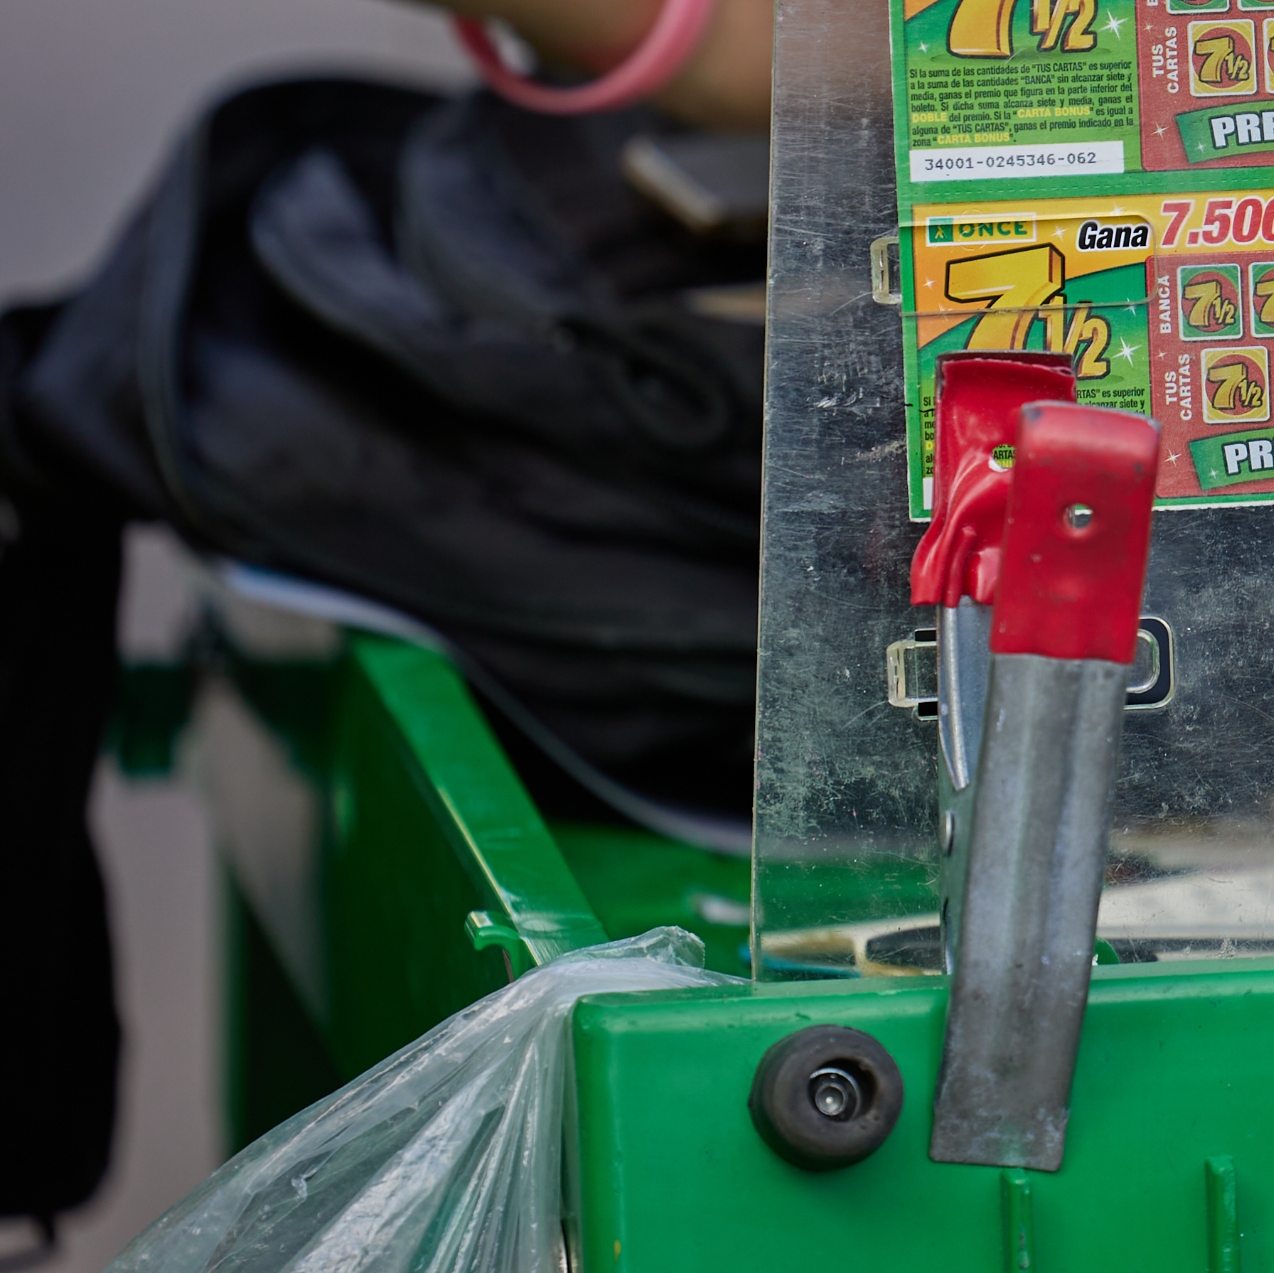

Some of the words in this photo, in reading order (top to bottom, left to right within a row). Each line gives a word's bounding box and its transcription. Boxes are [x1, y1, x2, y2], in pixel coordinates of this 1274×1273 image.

[1152, 43, 1165, 78] TUS
[1166, 26, 1178, 93] CARTAS
[913, 137, 931, 146] zona
[925, 152, 1097, 171] 34001-0245346-062
[958, 219, 1028, 238] ONCE
[1077, 221, 1148, 251] Gana
